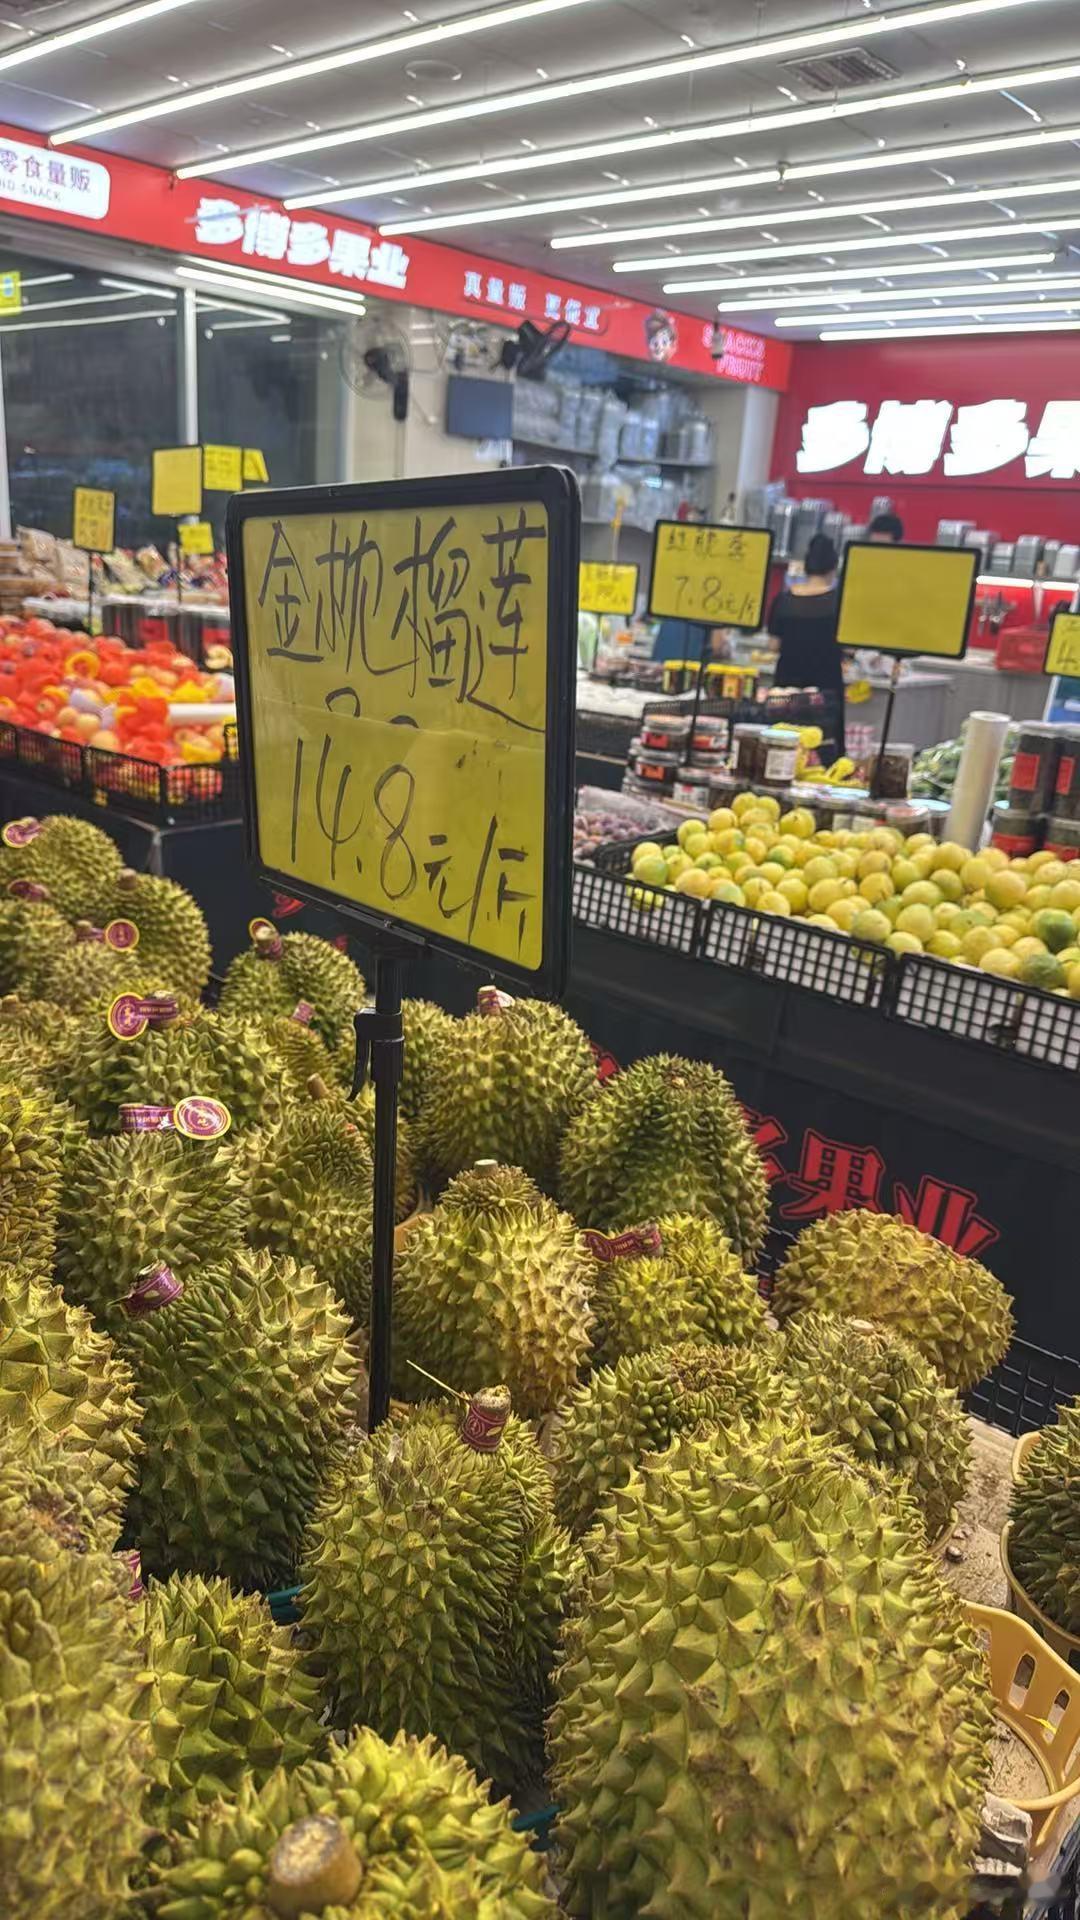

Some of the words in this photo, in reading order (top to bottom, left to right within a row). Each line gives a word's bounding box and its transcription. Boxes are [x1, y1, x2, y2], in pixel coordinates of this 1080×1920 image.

[258, 507, 547, 733] 金枕榴莲
[290, 733, 537, 959] 14.8元/斤
